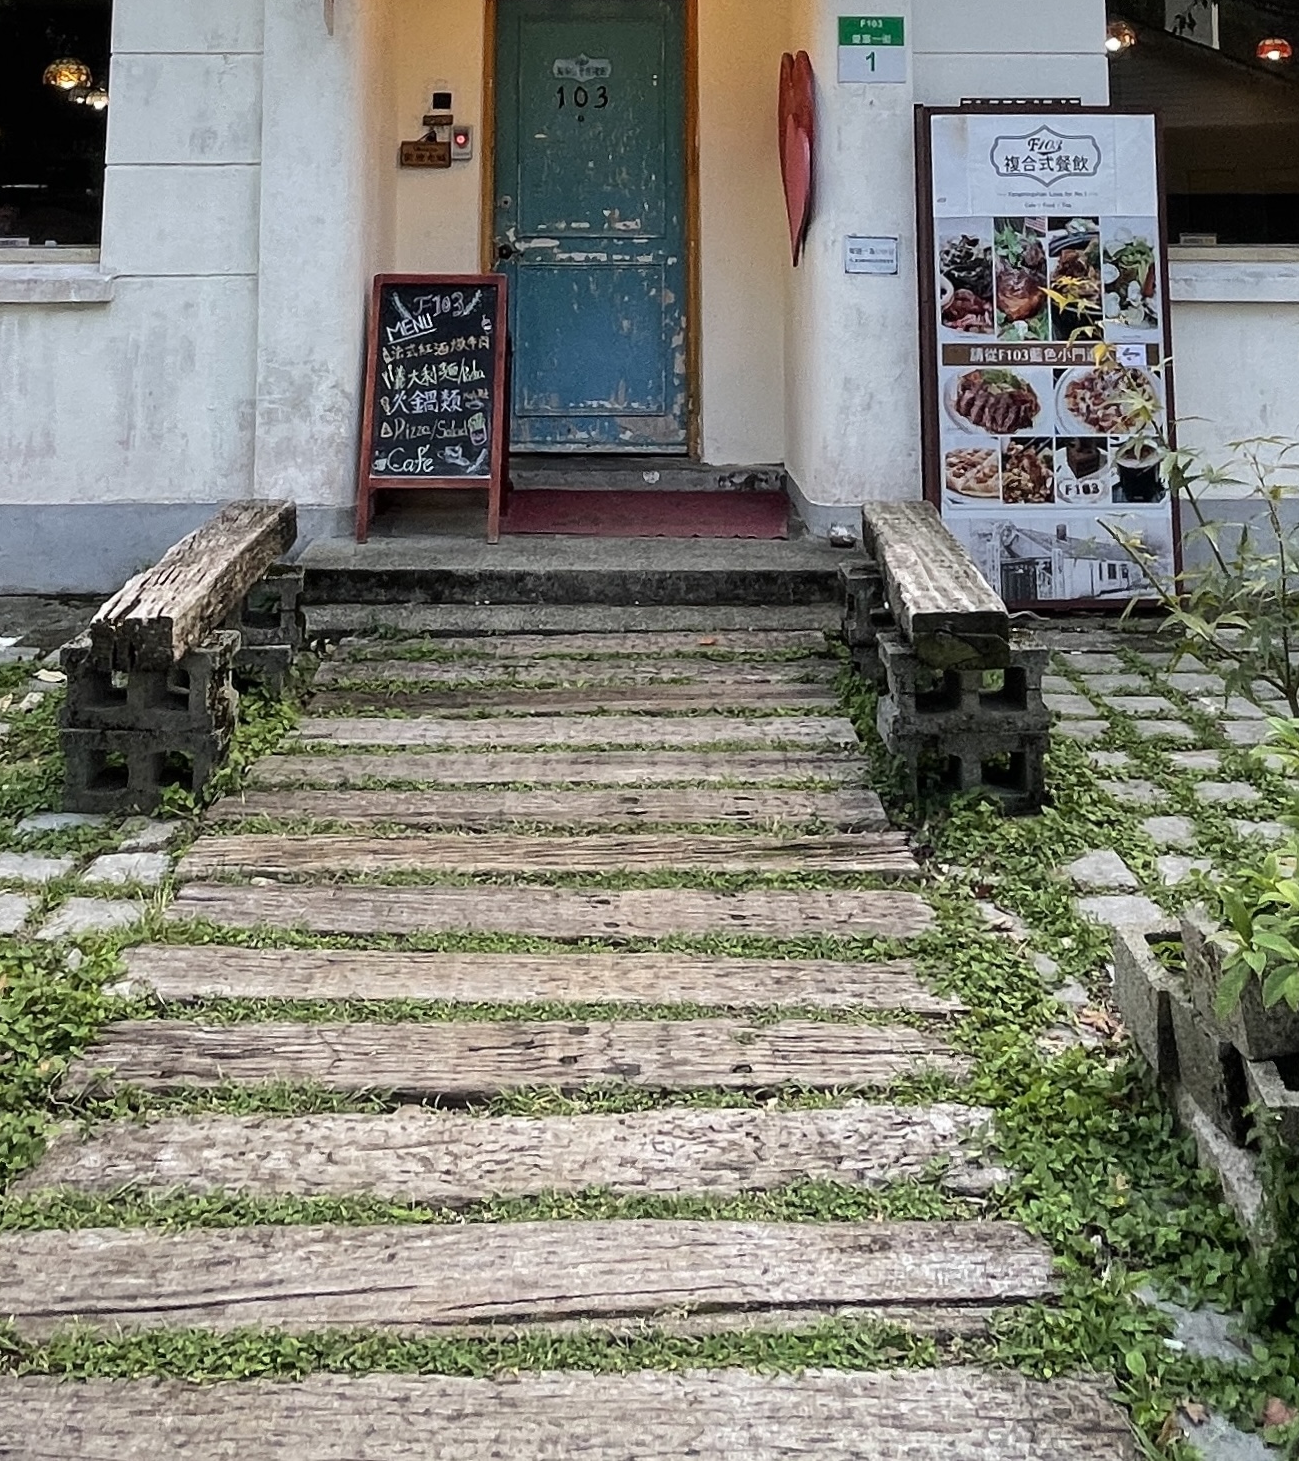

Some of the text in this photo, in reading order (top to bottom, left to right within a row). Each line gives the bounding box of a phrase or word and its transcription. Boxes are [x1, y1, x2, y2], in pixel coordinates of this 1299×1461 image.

[860, 19, 883, 28] F103
[866, 51, 875, 72] 1
[557, 86, 609, 109] 103
[1027, 137, 1063, 154] F103
[1004, 155, 1089, 172] 複合式餐飲
[413, 291, 465, 317] F103
[386, 313, 434, 343] MENU
[390, 389, 463, 415] 火鍋類
[387, 444, 435, 474] Cafe
